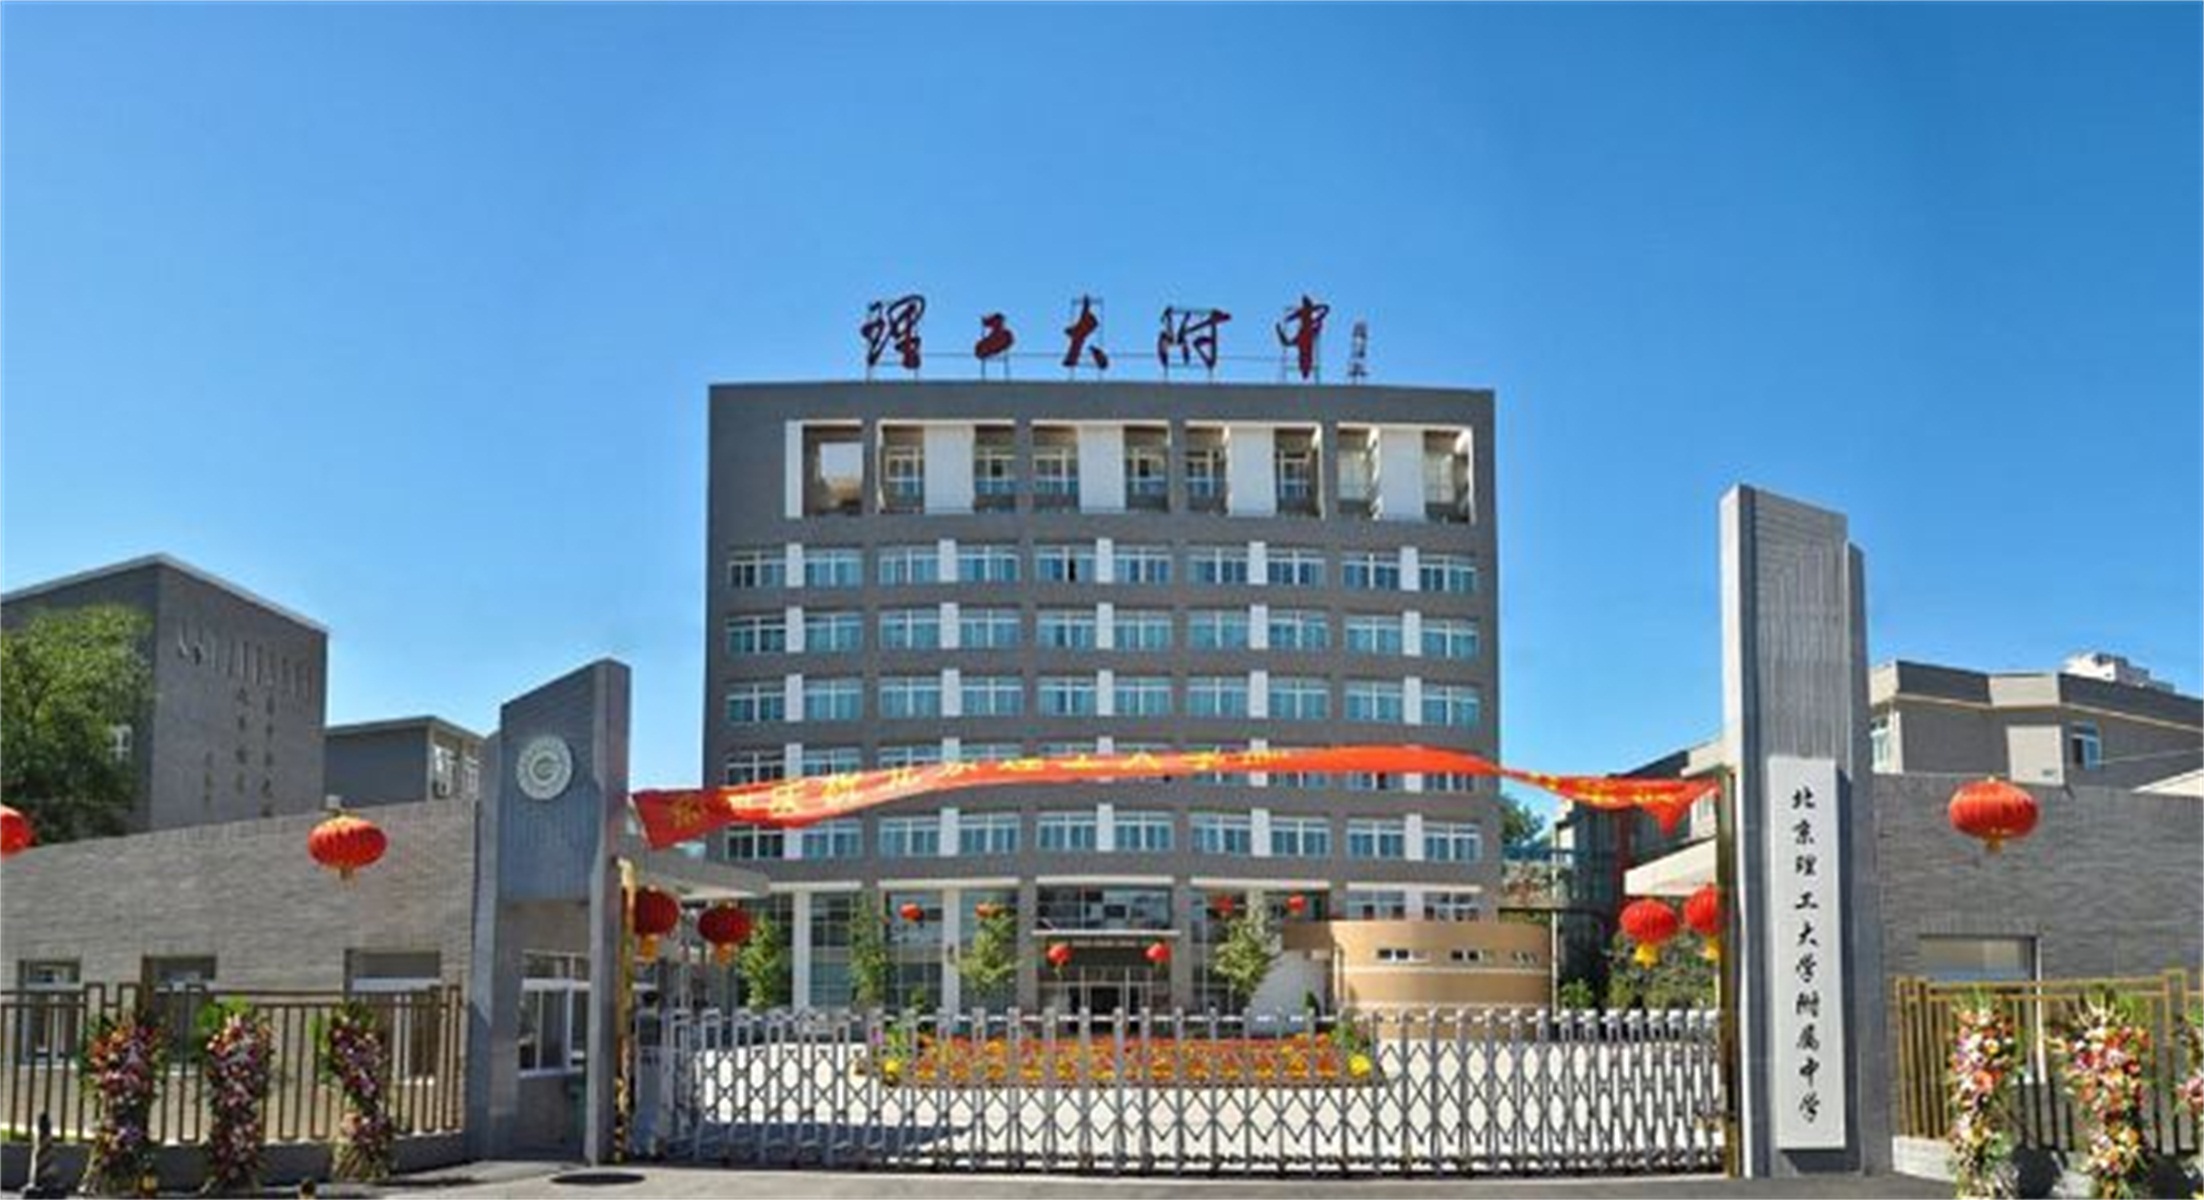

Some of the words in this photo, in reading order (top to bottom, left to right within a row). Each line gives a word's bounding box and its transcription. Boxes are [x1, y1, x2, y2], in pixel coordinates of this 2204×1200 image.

[861, 294, 1328, 378] 理工大附中
[1792, 786, 1820, 1122] 北京理工大学附属中学
